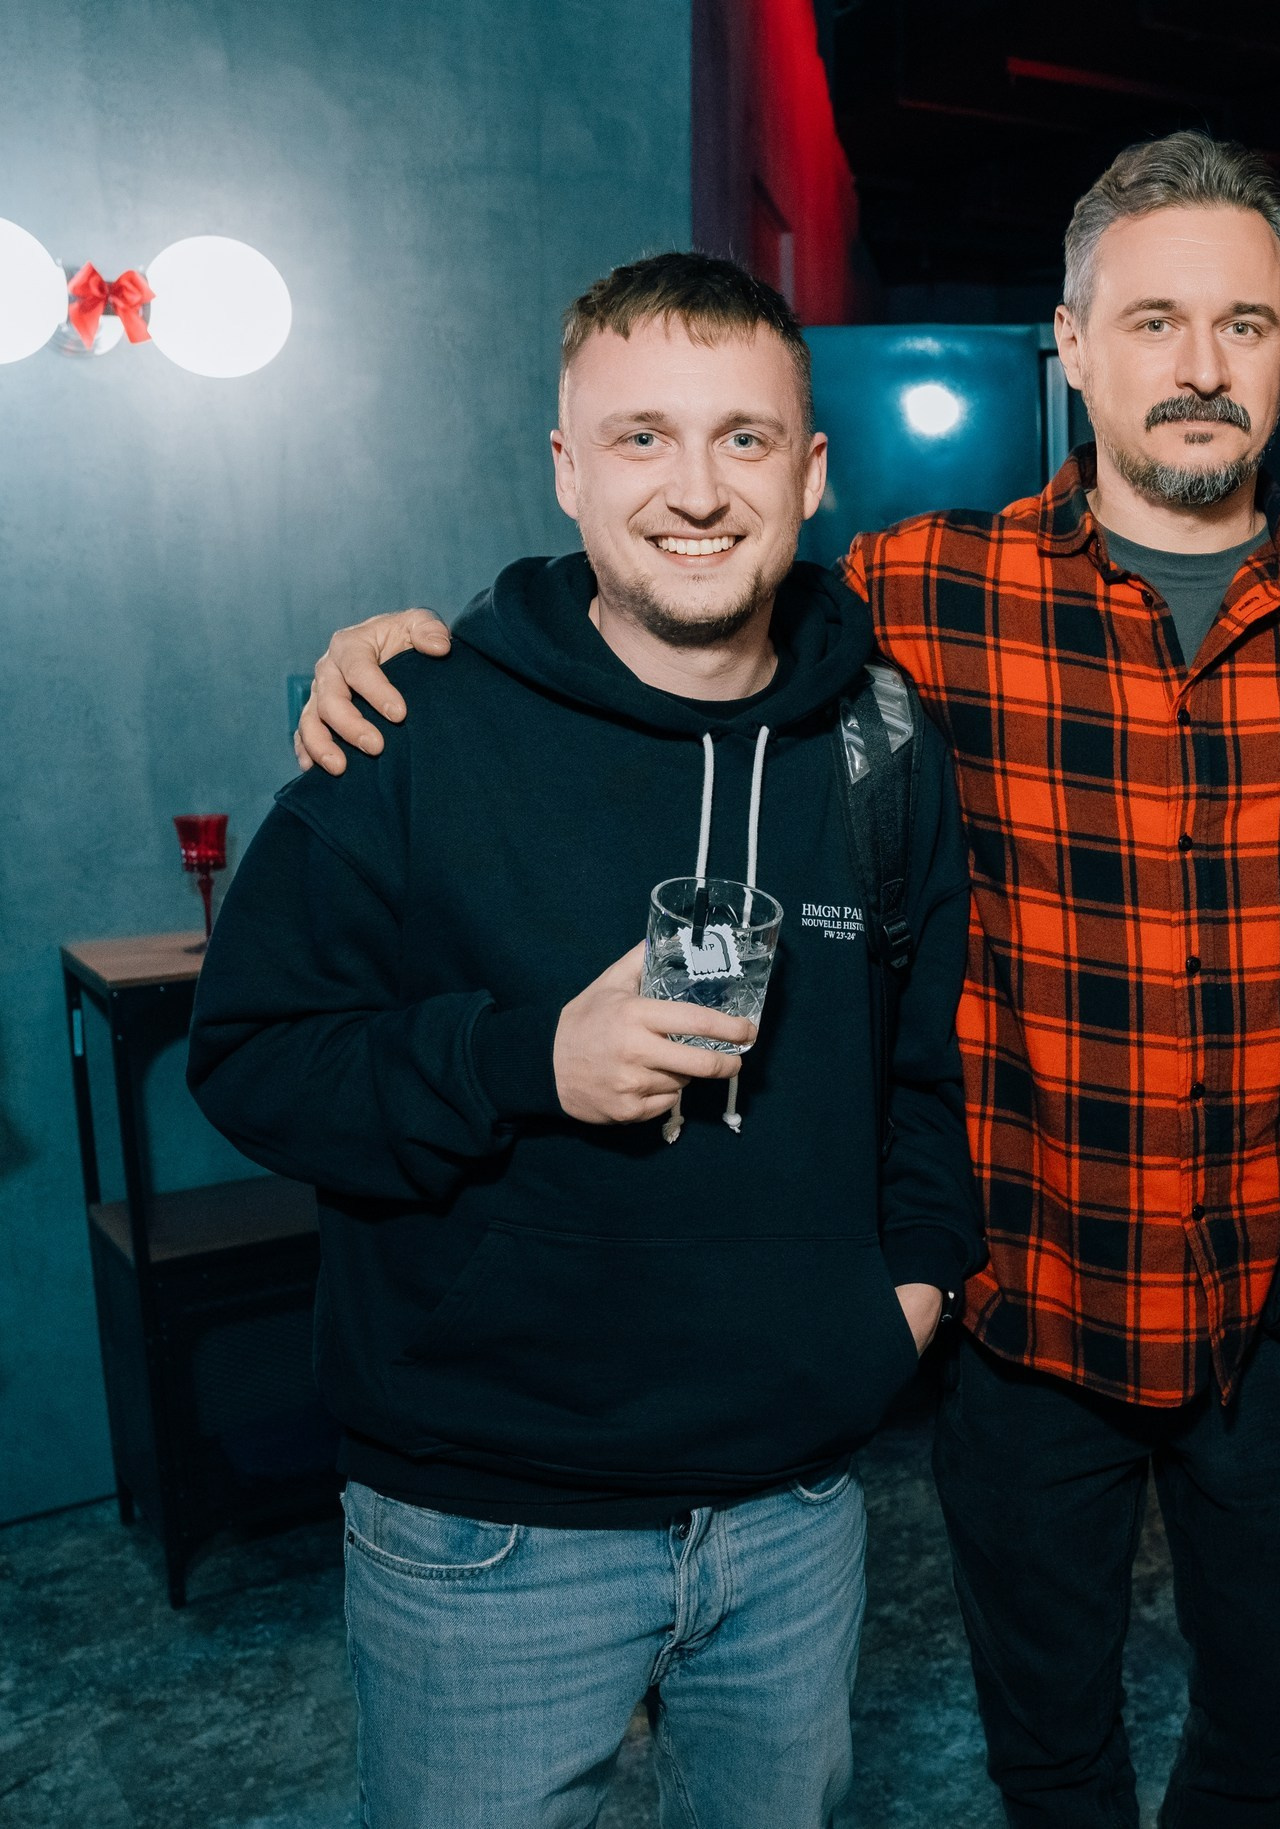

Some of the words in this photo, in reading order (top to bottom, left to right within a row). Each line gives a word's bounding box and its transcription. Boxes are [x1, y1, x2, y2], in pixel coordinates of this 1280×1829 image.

[801, 903, 841, 918] HMGN
[801, 917, 842, 929] NOUVELLE
[824, 930, 835, 939] FW
